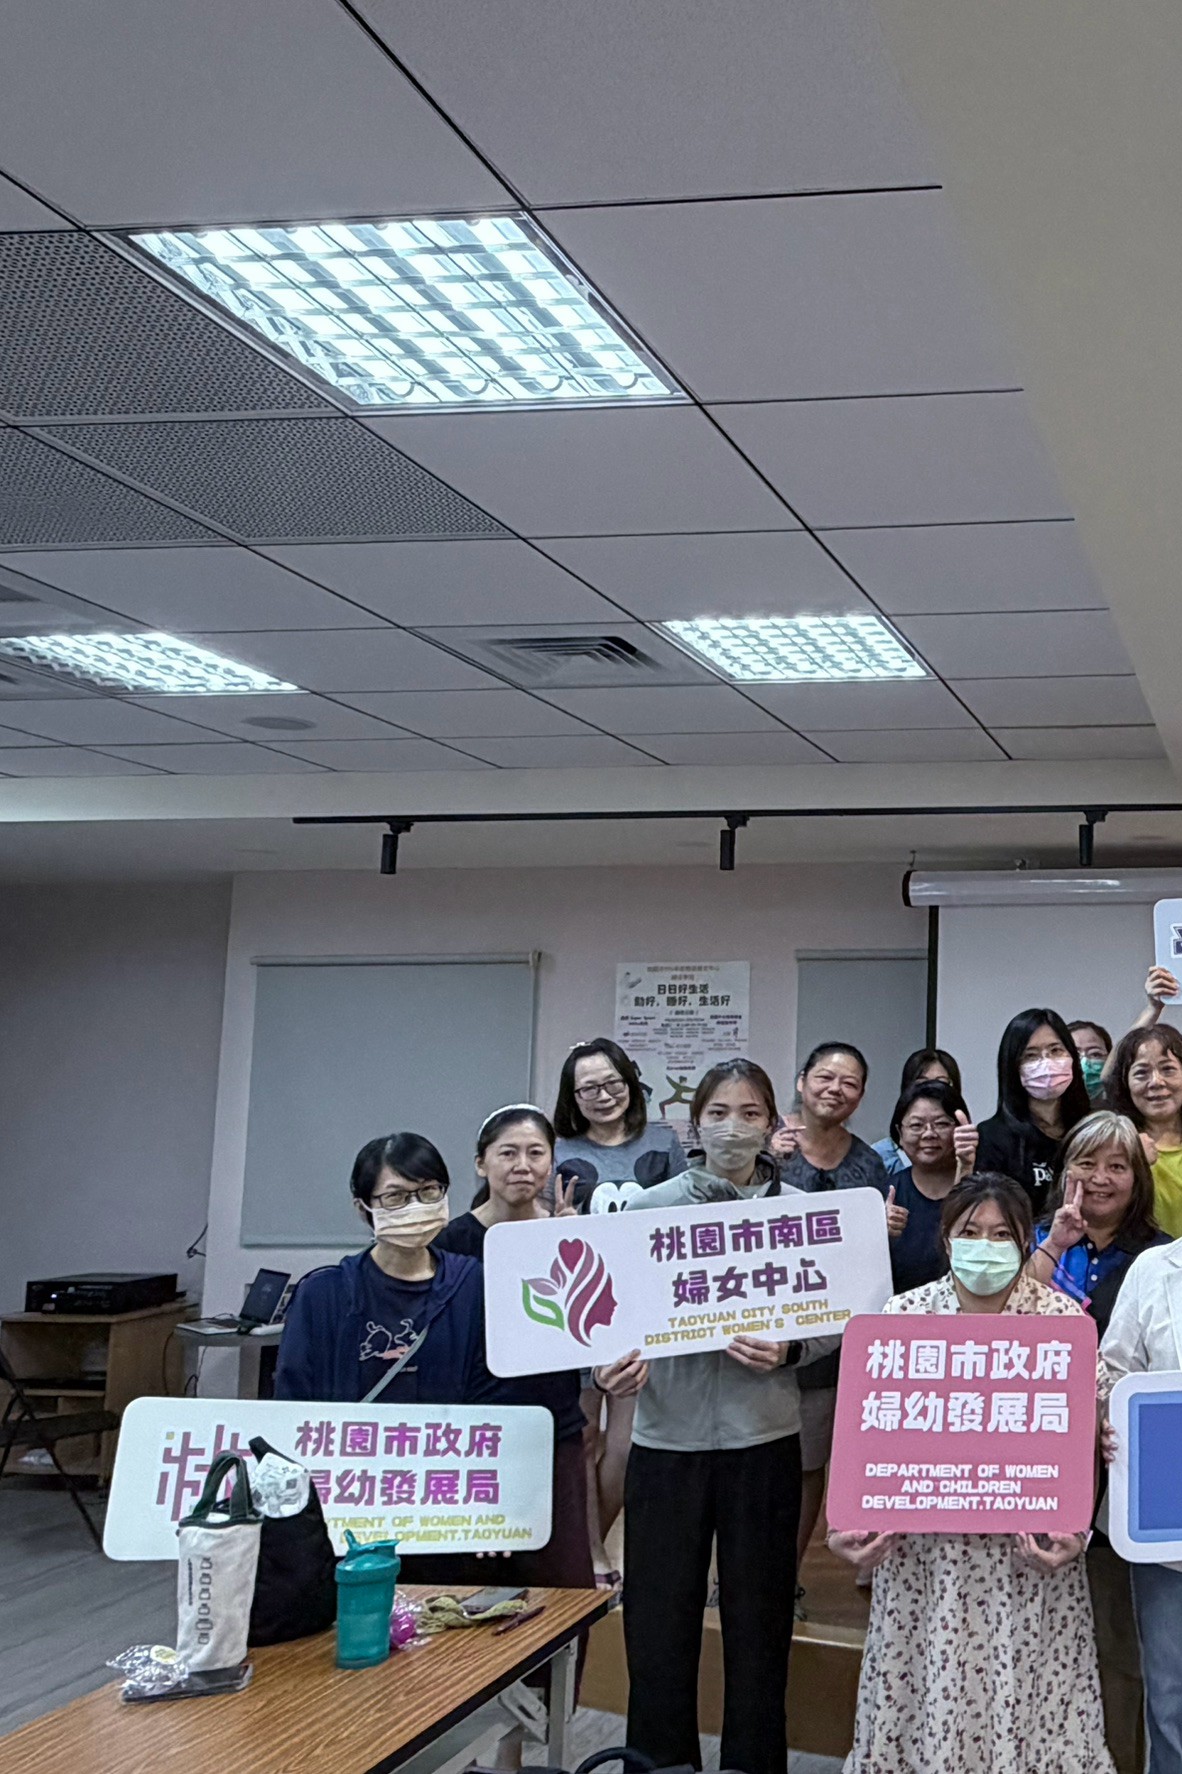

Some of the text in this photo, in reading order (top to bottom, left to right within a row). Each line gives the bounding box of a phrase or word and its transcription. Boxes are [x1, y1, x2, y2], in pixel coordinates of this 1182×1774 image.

[649, 1209, 844, 1263] 桃園市南區
[672, 1258, 828, 1308] 婦女中心
[644, 1327, 716, 1346] DISTRICT
[796, 1309, 852, 1326] CENTER
[667, 1299, 829, 1328] TAOYUAN CITY SOUTH
[865, 1339, 1073, 1381] 桃園市政府
[860, 1391, 1070, 1433] 婦幼發展局
[294, 1420, 503, 1459] 桃園市政府
[865, 1464, 1059, 1478] DEPARTMENT OF WOMEN
[901, 1480, 1021, 1494] AND CHILDREN
[391, 1515, 414, 1528] OF
[419, 1515, 472, 1527] WOMEN
[475, 1514, 506, 1526] AND
[861, 1496, 1058, 1511] DEVELOPMENT.TAOYUAN
